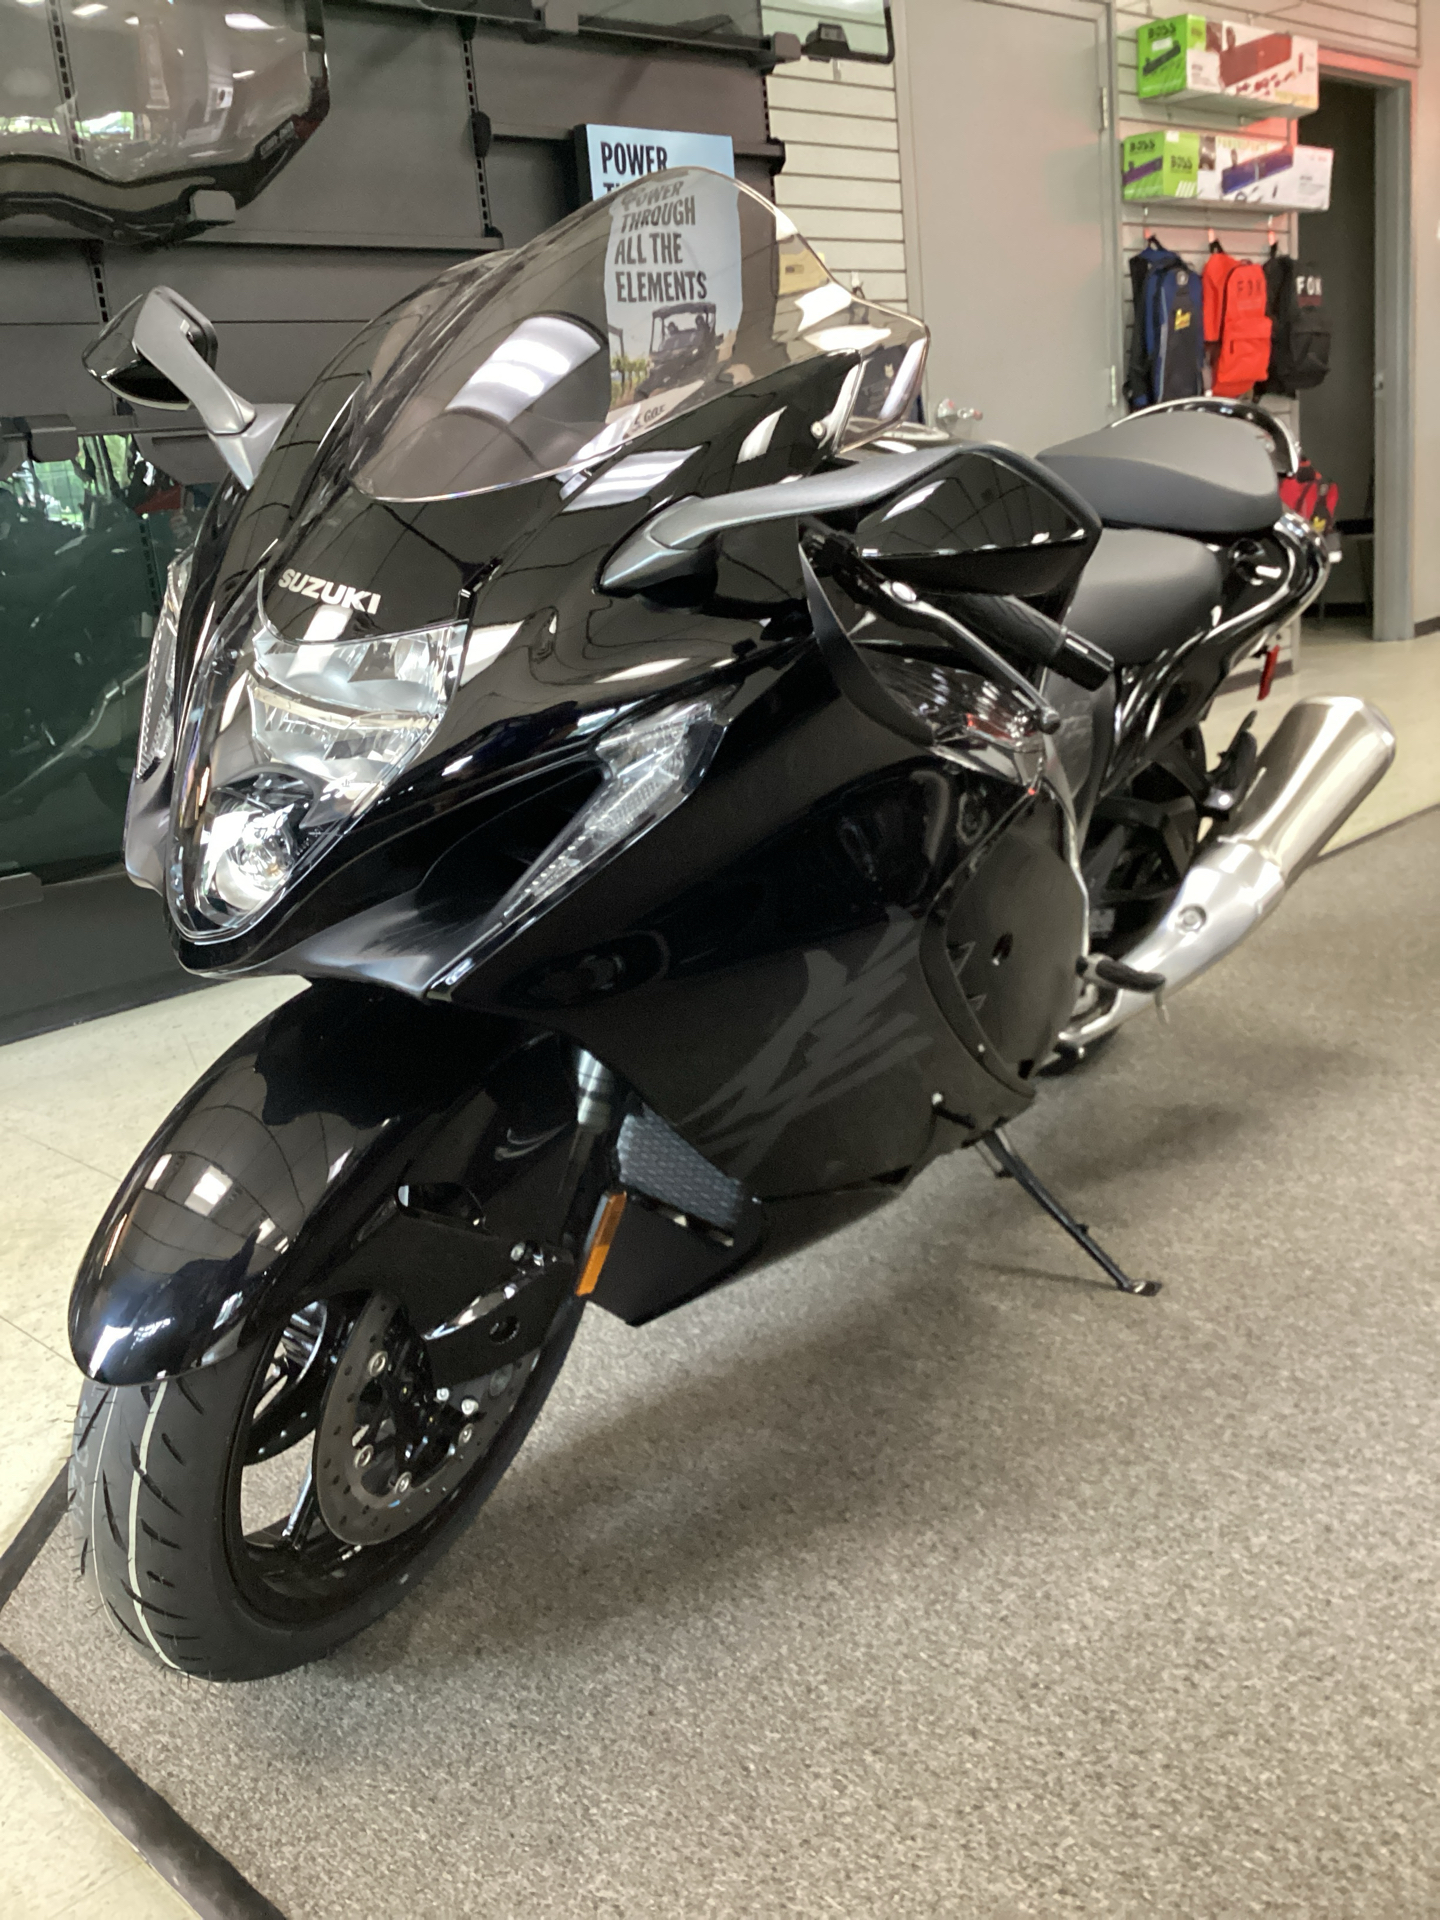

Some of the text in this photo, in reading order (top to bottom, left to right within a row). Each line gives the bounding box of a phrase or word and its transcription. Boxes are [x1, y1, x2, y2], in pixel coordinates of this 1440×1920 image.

[600, 141, 668, 176] POWER
[620, 195, 696, 233] THROUGH
[614, 232, 683, 265] ALL THE
[615, 270, 708, 303] ELEMENTS
[278, 568, 381, 615] SUZUKI
